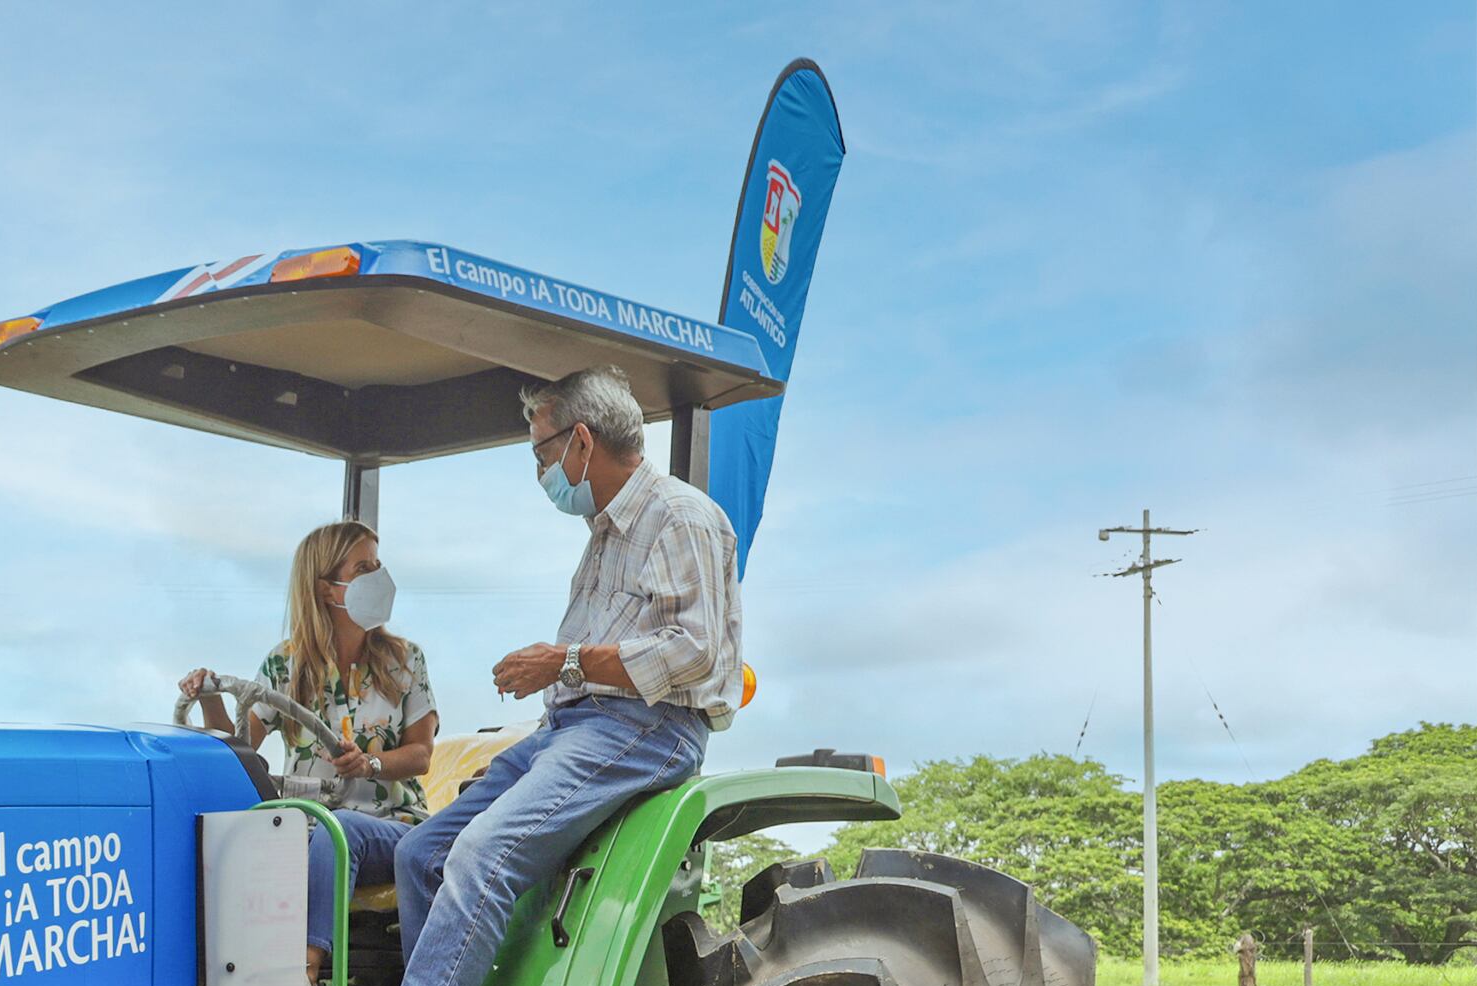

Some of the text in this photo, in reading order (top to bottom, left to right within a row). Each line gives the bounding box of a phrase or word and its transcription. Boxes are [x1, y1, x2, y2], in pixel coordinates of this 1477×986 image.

[425, 247, 450, 274] El
[455, 259, 525, 297] campo
[553, 283, 612, 321] TODA
[617, 301, 714, 352] MARCHA!
[16, 832, 121, 876] campo
[4, 868, 133, 927] ¡A TODA
